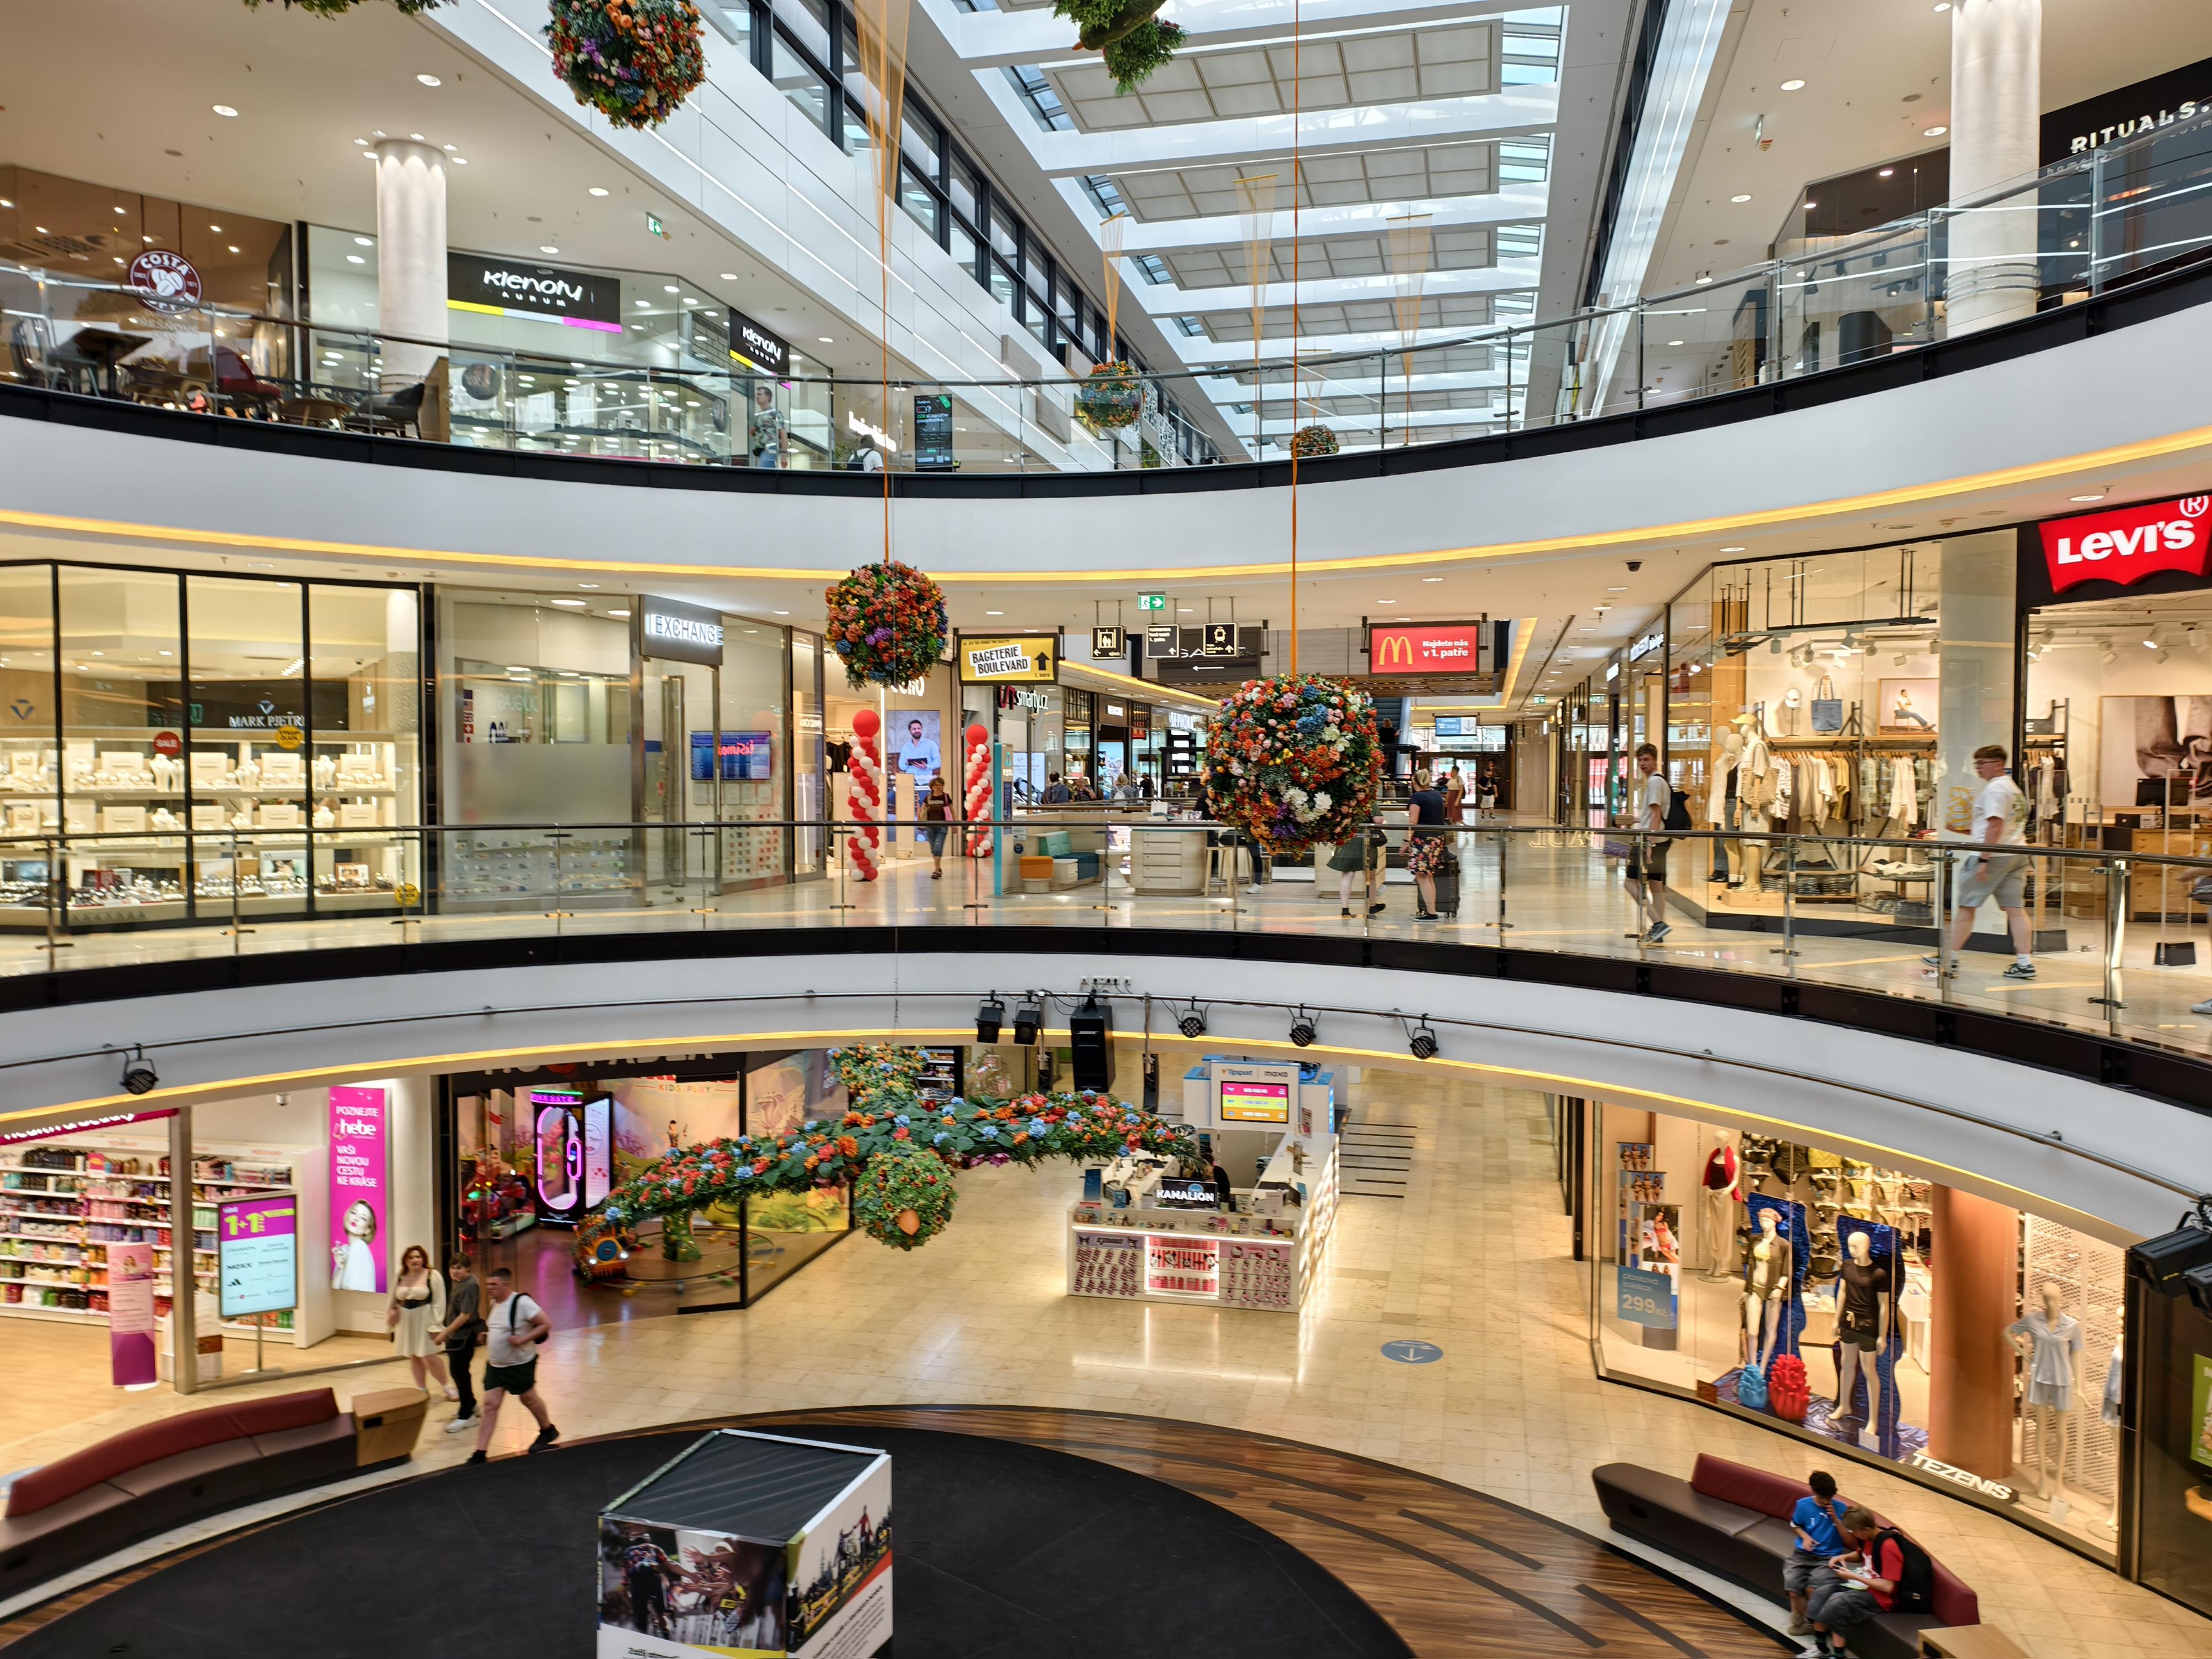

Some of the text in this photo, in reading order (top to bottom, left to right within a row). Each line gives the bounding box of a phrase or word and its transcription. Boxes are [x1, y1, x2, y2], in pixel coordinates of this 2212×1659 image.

[140, 254, 189, 276] COSTA
[502, 291, 566, 307] AURUM
[653, 614, 724, 646] EXCHANGE
[1422, 640, 1453, 649] Najdete
[972, 646, 1019, 664] BAGETERIE
[1440, 648, 1469, 659] patře
[978, 659, 1028, 675] BOULEVARD
[229, 716, 265, 728] MARK
[155, 738, 178, 748] SALE
[659, 1083, 712, 1094] KIDS PLAY
[340, 1118, 377, 1136] hebe
[336, 1155, 370, 1167] NOVOU
[336, 1165, 365, 1177] CESTU
[336, 1175, 349, 1186] KE
[1156, 1189, 1214, 1202] KAMALION
[1621, 1293, 1656, 1314] 299
[1912, 1452, 2013, 1500] TEZENIS
